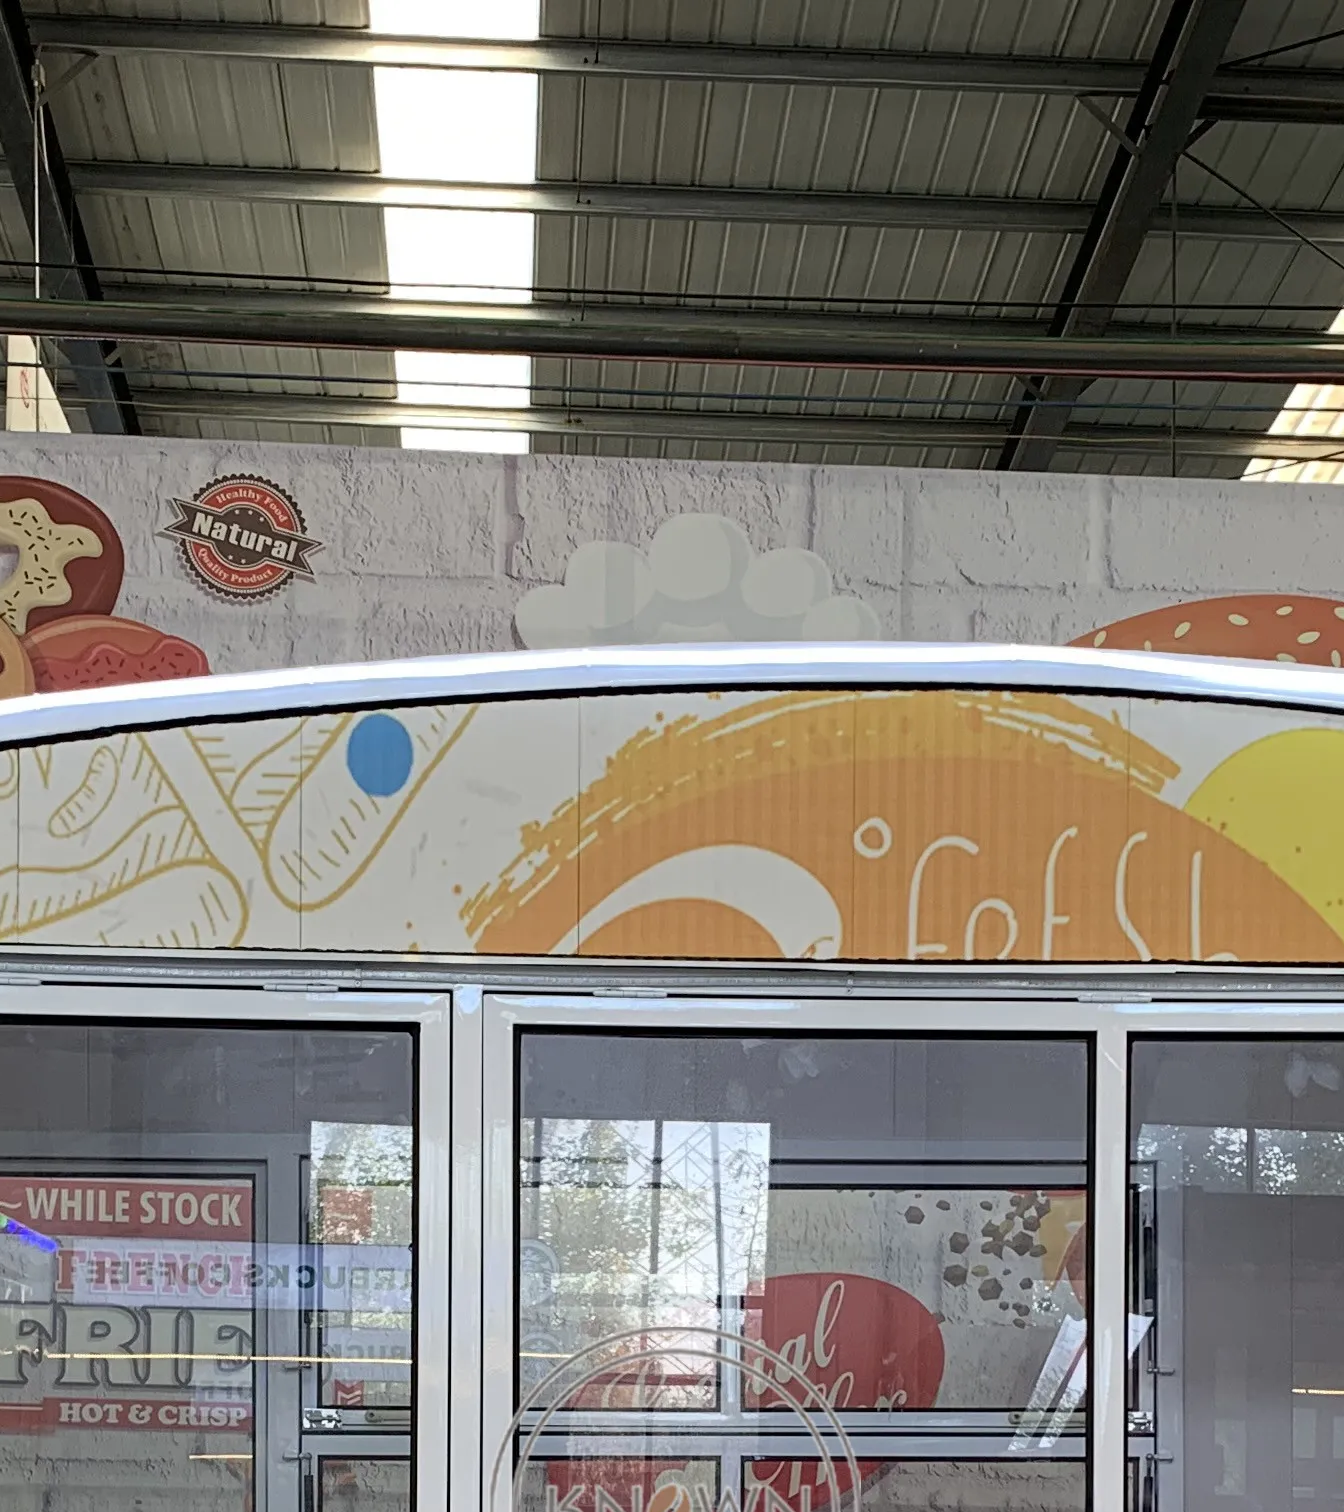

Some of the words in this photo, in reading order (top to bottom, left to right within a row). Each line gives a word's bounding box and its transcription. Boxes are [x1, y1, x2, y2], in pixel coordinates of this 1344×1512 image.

[216, 488, 262, 505] Healthy
[263, 495, 289, 523] Food
[191, 511, 298, 563] Natural
[197, 546, 230, 582] Quality
[229, 568, 274, 584] Product
[25, 1187, 131, 1224] WHILE
[139, 1189, 243, 1227] STOCK
[59, 1402, 124, 1425] HOT
[128, 1402, 153, 1424] &
[158, 1403, 249, 1428] CRISP
